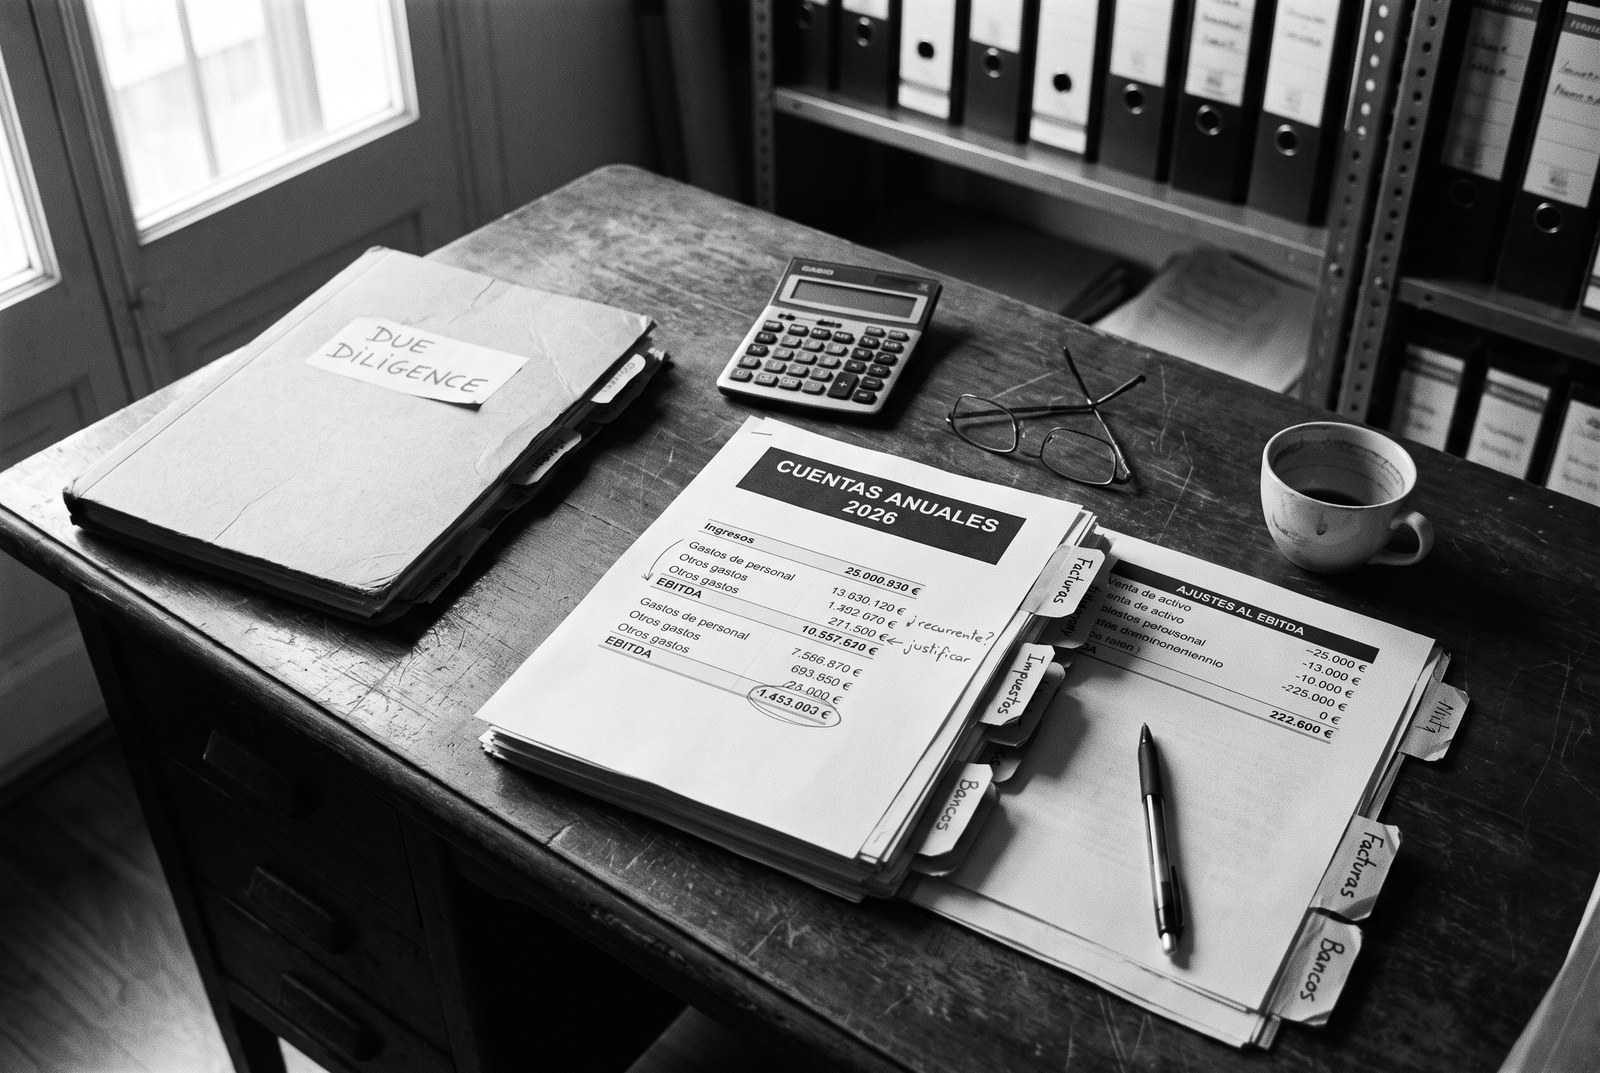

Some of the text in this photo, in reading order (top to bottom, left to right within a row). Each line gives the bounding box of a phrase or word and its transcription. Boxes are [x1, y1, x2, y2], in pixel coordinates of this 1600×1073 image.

[366, 326, 435, 354] DUE
[776, 460, 1000, 533] CUENTAS ANUALES
[841, 501, 899, 525] 2026
[704, 522, 755, 544] Ingresos
[679, 553, 710, 569] Otros
[709, 566, 748, 582] gastos
[689, 541, 727, 559] Gastos
[729, 554, 744, 565] de
[745, 561, 796, 581] personal
[832, 587, 895, 612] 13.630.120
[1052, 556, 1094, 606] Facturas
[656, 577, 702, 599] EBITDA
[668, 564, 700, 581] Otros
[700, 577, 740, 594] gastos
[827, 616, 877, 638] 271.500
[1108, 576, 1138, 594] Venta
[1141, 588, 1156, 600] de
[1158, 595, 1192, 612] activo
[629, 610, 660, 627] Otros
[661, 623, 701, 641] gastos
[640, 597, 680, 617] Gastos
[682, 612, 697, 623] de
[697, 619, 750, 641] personal
[1176, 585, 1305, 636] AJUSTES AL EBITDA
[604, 635, 652, 658] EBITDA
[617, 623, 649, 639] Otros
[649, 635, 690, 654] gastos
[903, 640, 971, 662] justificar
[1106, 592, 1131, 607] enta
[1133, 600, 1149, 611] de
[1150, 607, 1184, 624] activo
[1302, 661, 1349, 682] -13.000
[997, 653, 1046, 715] Impuestos
[1281, 684, 1336, 707] -225.000
[1295, 673, 1342, 695] -10.000
[1268, 709, 1321, 734] 222.600
[1319, 711, 1328, 720] 0
[936, 778, 980, 832] Bancos
[1340, 832, 1384, 899] Facturas
[1300, 937, 1345, 1003] Bancos
